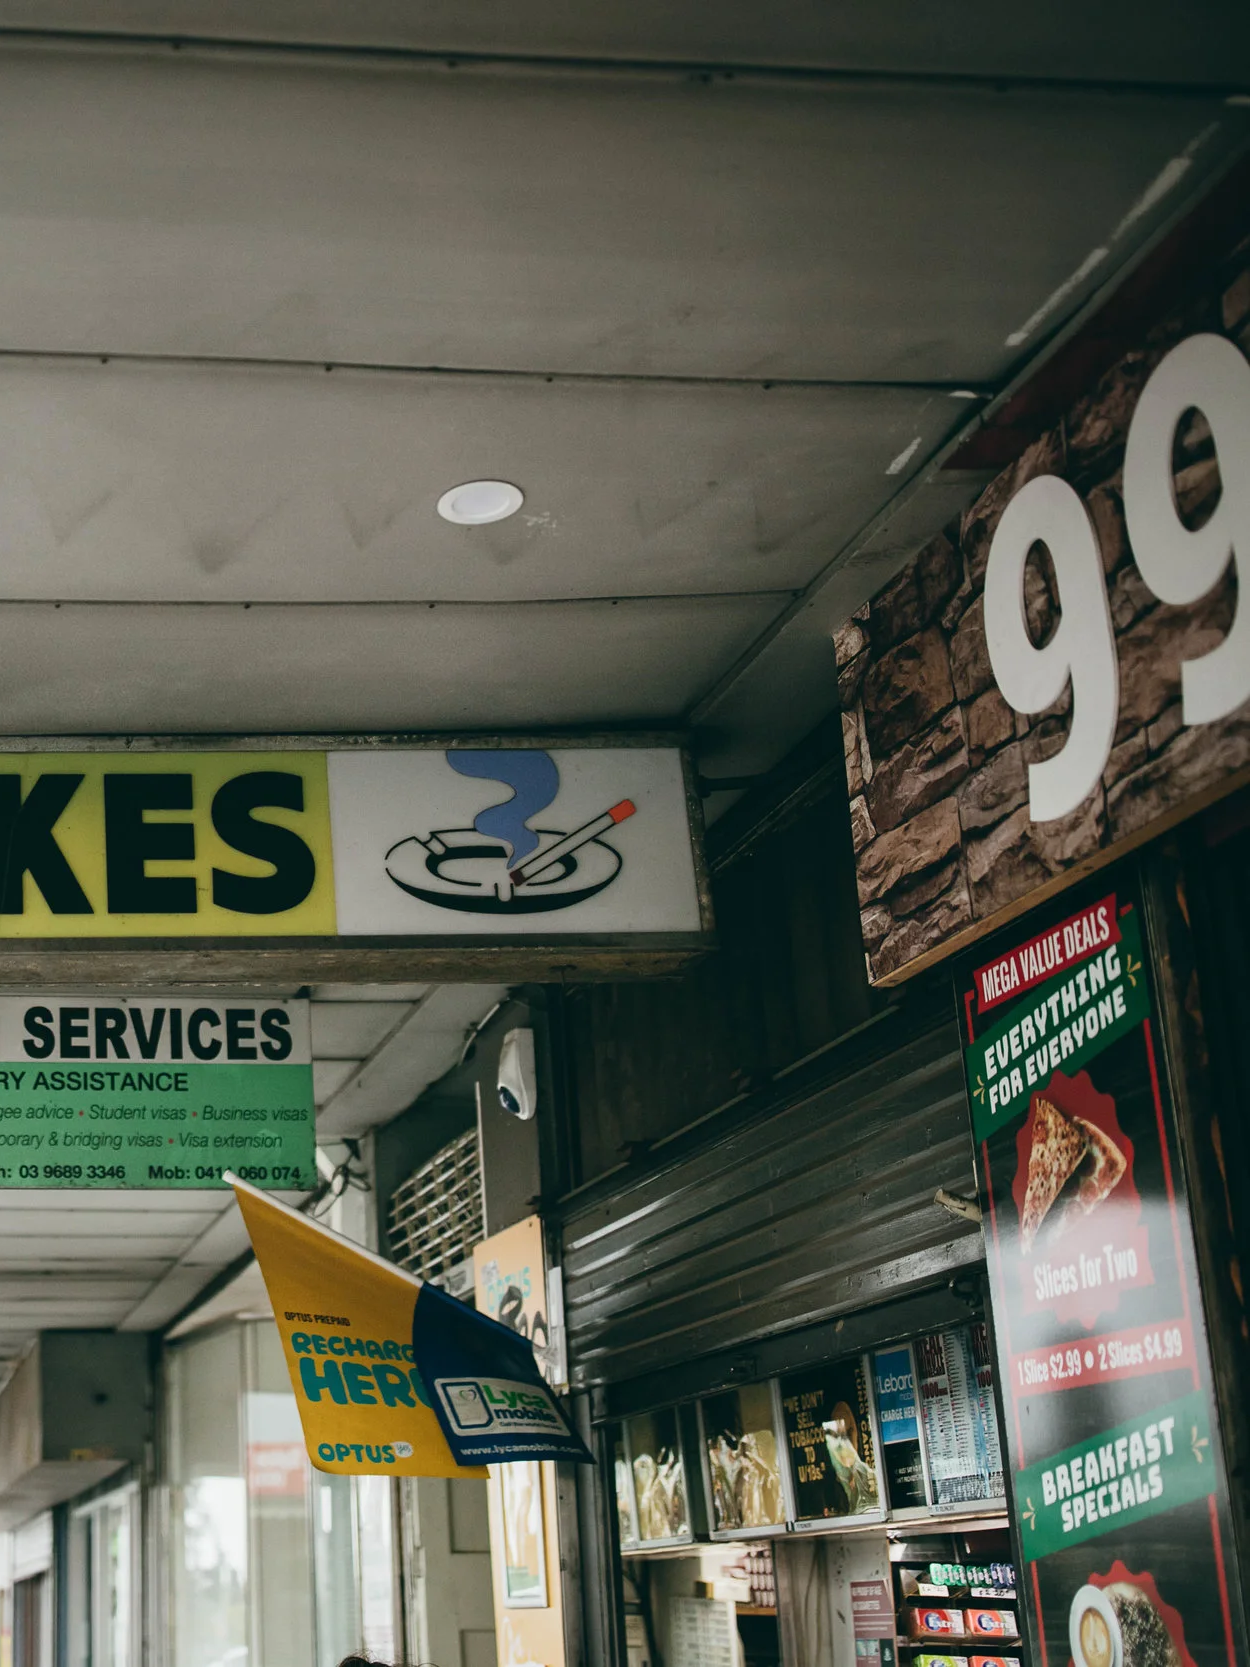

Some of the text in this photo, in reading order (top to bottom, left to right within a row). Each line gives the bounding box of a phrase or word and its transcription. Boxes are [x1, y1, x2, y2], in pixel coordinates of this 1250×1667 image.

[982, 906, 1110, 1003] MEGA VALUE DEALS
[984, 944, 1122, 1080] EVERYTHING
[22, 1006, 293, 1061] SERVICES
[988, 984, 1127, 1115] FOR EVERYONE
[33, 1072, 189, 1092] ASSISTANCE
[25, 1104, 74, 1120] advice
[88, 1105, 147, 1120] Student
[150, 1106, 187, 1121] visas
[202, 1106, 268, 1122] Business
[271, 1107, 309, 1121] visas
[48, 1132, 58, 1147] &
[63, 1131, 122, 1151] bridging
[126, 1133, 163, 1147] visas
[179, 1133, 209, 1148] Visa
[213, 1134, 283, 1149] extension
[19, 1165, 38, 1179] 03
[43, 1165, 82, 1179] 9689
[86, 1166, 126, 1180] 3346
[148, 1166, 190, 1180] Mob:
[195, 1166, 232, 1180] 041
[271, 1166, 301, 1180] 074
[1033, 1244, 1138, 1301] Slices for Two
[284, 1311, 351, 1327] OPTUS PREPAID
[291, 1331, 417, 1364] RECHARG
[1017, 1327, 1183, 1386] 1 Slice $2.99 2 Slices $4.99
[482, 1384, 550, 1410] Lyca
[493, 1406, 558, 1423] mobile
[317, 1442, 397, 1464] OPTUS
[804, 1446, 816, 1463] TO
[1042, 1417, 1175, 1506] BREAKFAST
[1060, 1468, 1163, 1534] SPECIALS
